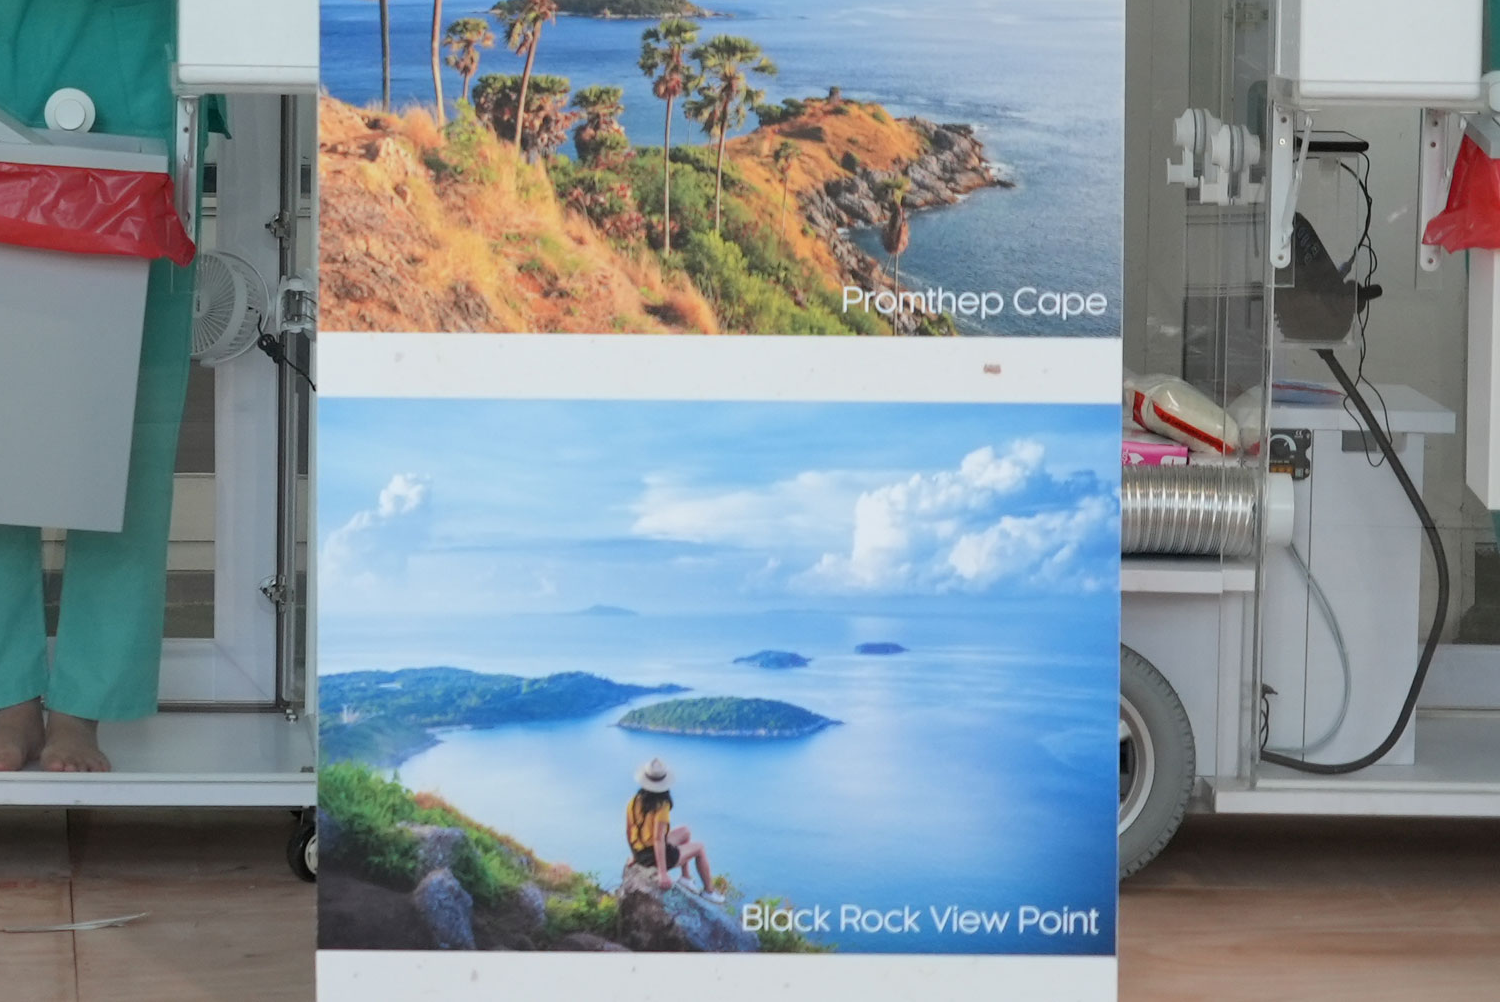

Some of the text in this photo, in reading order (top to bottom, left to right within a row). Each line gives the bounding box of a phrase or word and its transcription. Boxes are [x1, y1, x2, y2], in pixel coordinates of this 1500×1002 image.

[842, 286, 1108, 321] Promthep Cape
[741, 903, 1100, 935] Black Rock View Point
